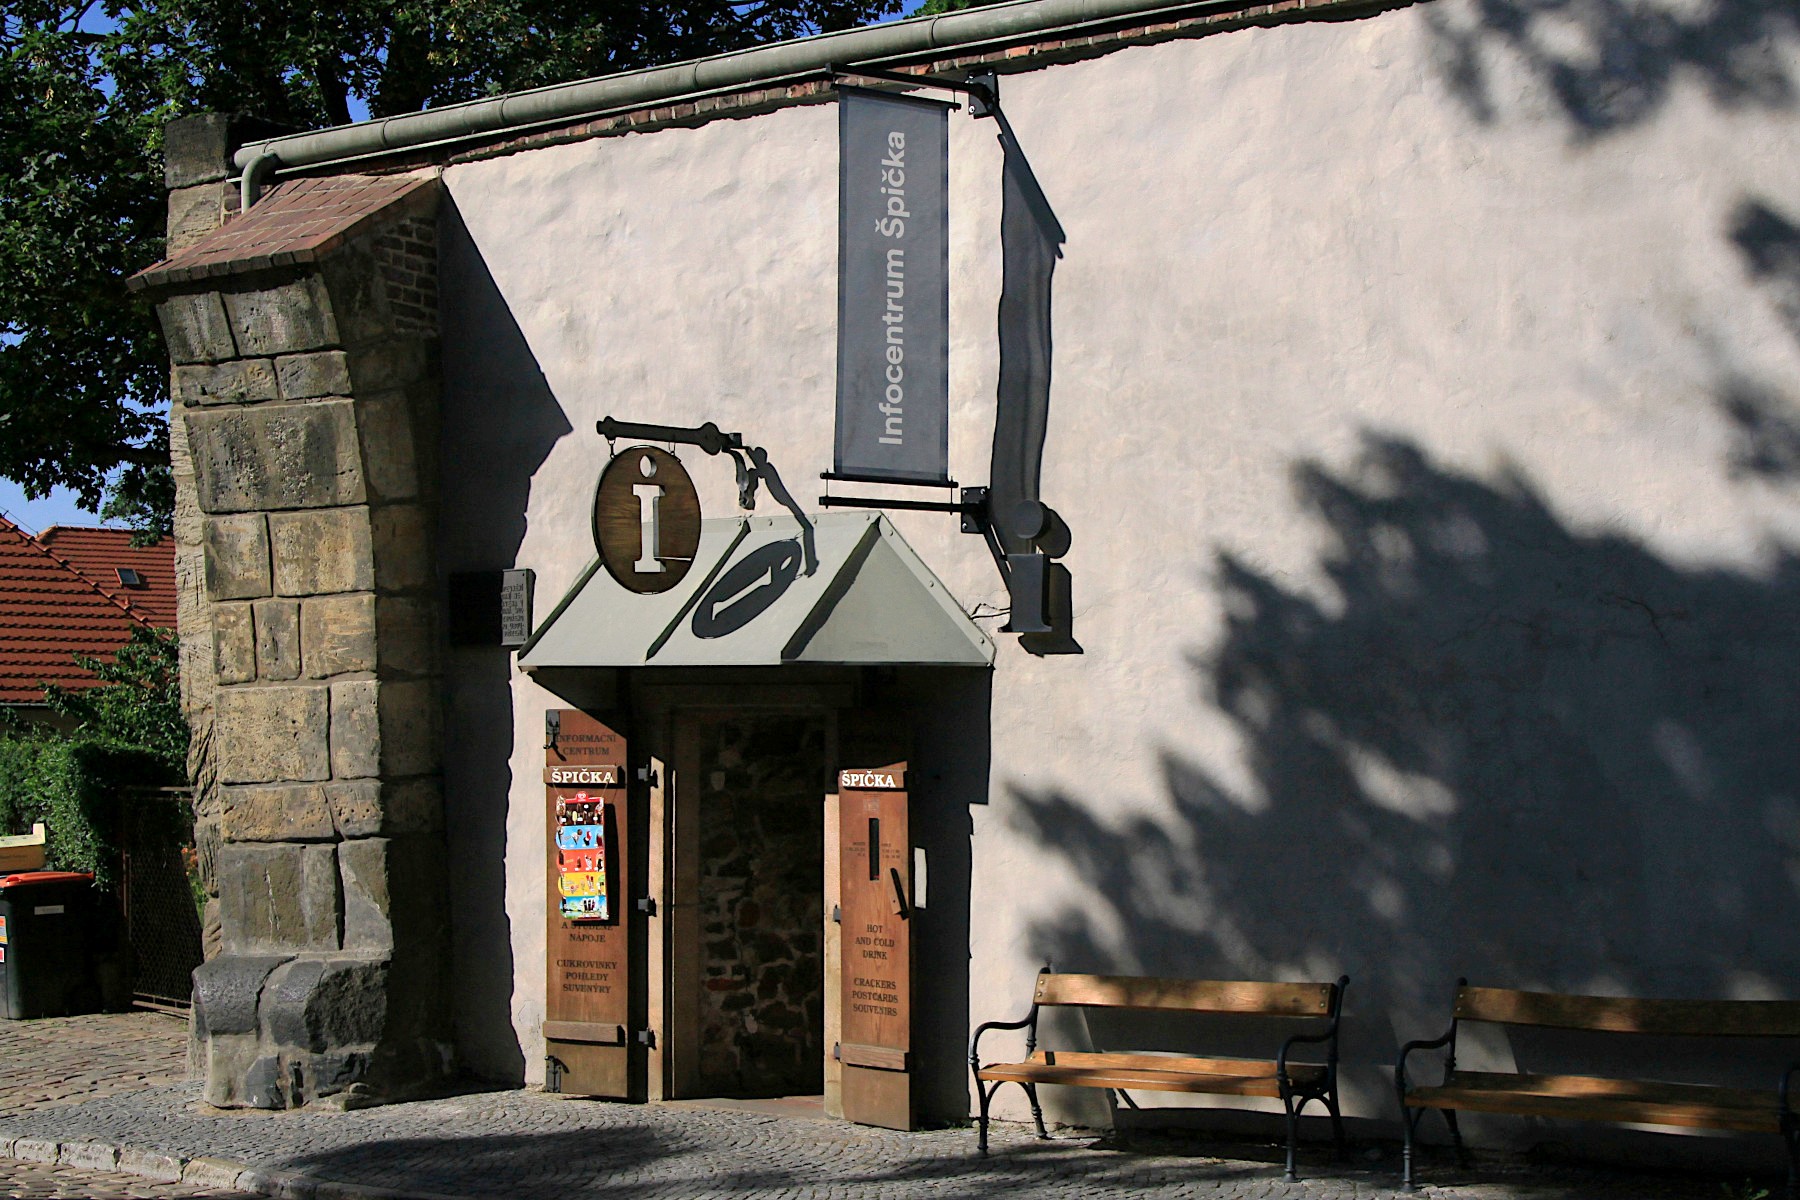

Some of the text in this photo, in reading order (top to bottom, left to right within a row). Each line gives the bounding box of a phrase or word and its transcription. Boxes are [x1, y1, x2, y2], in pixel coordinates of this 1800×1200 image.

[874, 130, 910, 447] Infocentrum Špička
[563, 746, 609, 756] CENTRUM
[551, 768, 616, 783] ŠPIČKA
[841, 769, 896, 788] ŠPIČKA
[866, 924, 883, 934] HOT
[855, 936, 895, 948] AND COLD
[862, 950, 888, 960] DRINK
[556, 959, 618, 970] CUKROVINKY
[565, 971, 609, 981] POHLEDY
[853, 977, 897, 990] CRACKERS
[851, 990, 899, 1004] POSTCARDS
[852, 1003, 898, 1017] SOUVENIRS
